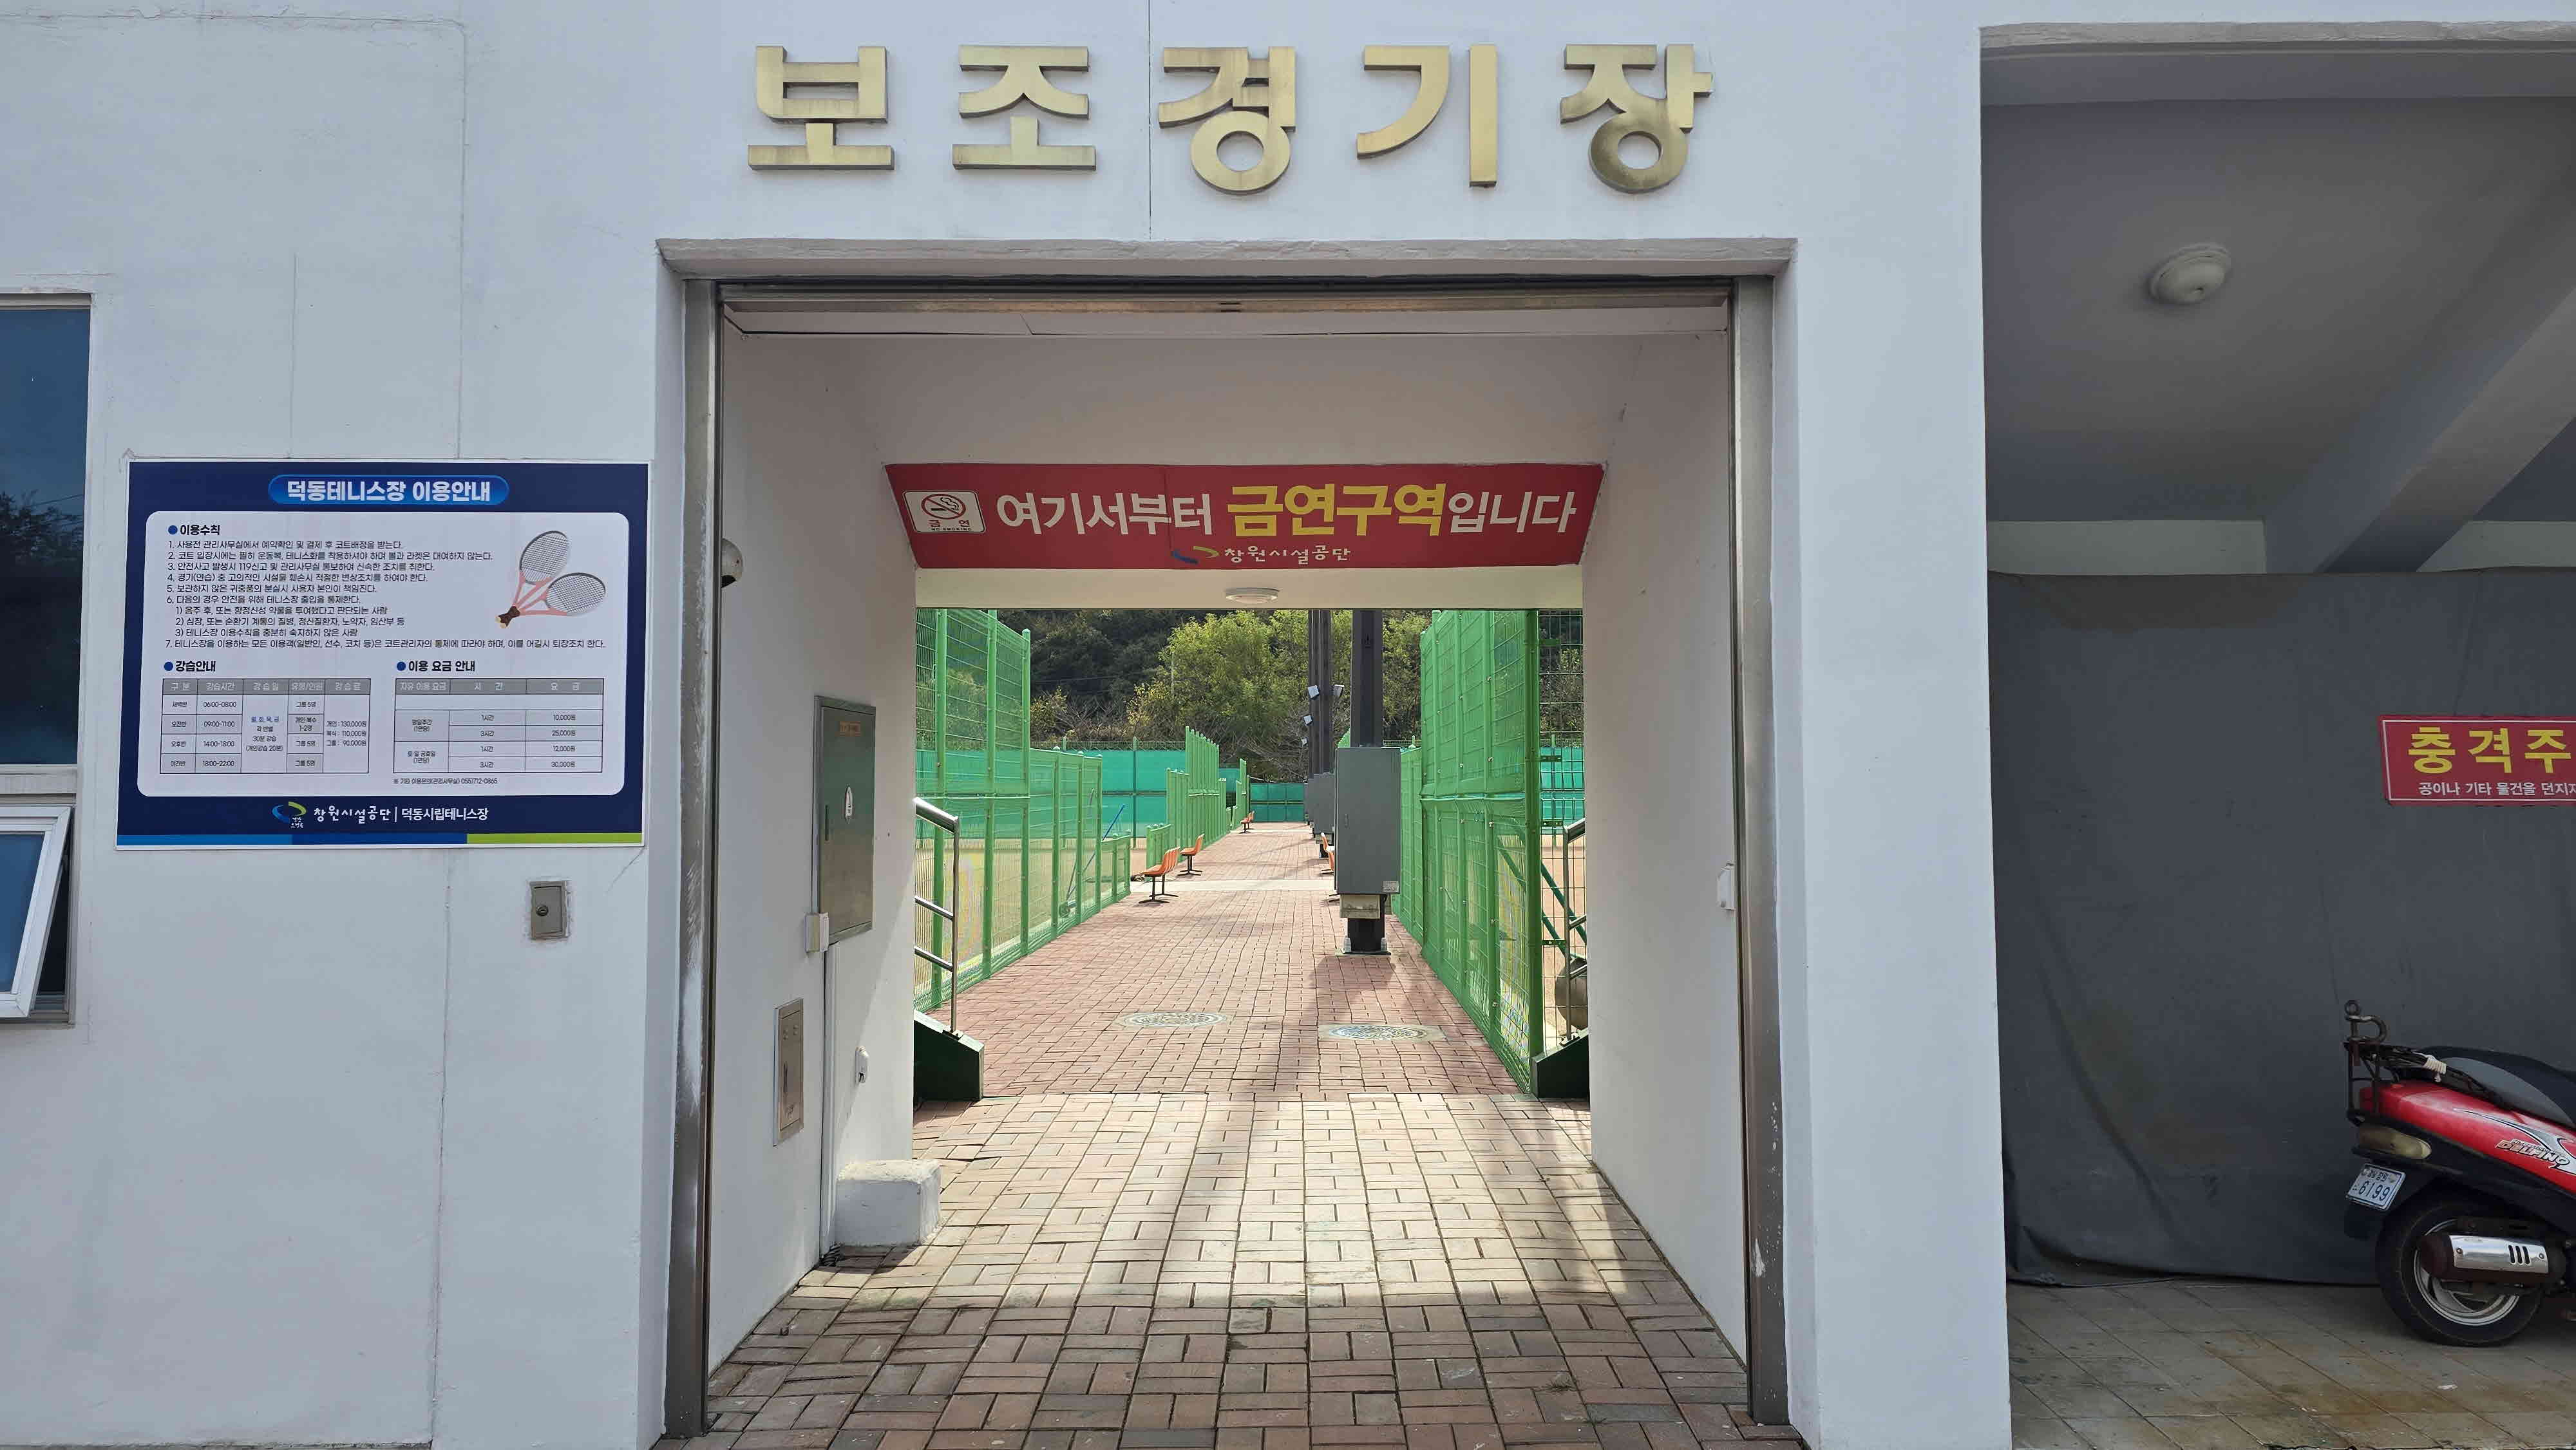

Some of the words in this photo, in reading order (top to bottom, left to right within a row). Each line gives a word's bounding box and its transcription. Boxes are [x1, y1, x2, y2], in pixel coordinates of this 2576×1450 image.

[748, 44, 1713, 195] 보조경기장
[288, 481, 406, 501] 덕동테니스장
[412, 481, 490, 501] 이용안내
[996, 493, 1211, 535] 여기서부터
[180, 525, 220, 535] 이용수칙
[1224, 545, 1351, 565] 창원시설공단
[166, 639, 172, 648] 7.
[175, 639, 214, 648] 테니스장을
[218, 639, 249, 648] 이용하는
[252, 639, 268, 648] 모든
[345, 639, 360, 648] 코치
[363, 639, 381, 648] 등)은
[384, 639, 432, 648] 코트관리자의
[462, 639, 485, 648] 따라야
[527, 639, 549, 648] 어길시
[553, 639, 584, 648] 퇴장조치
[175, 661, 216, 672] 강습안내
[408, 661, 428, 672] 이용
[431, 661, 451, 672] 요금
[455, 661, 475, 672] 안내
[2418, 782, 2460, 796] 공이나
[2465, 782, 2492, 795] 기타
[2496, 782, 2536, 795] 물건을
[314, 805, 391, 824] 창원시설공단
[401, 807, 489, 821] 덕동시립테니스장
[2495, 1139, 2570, 1167] DELFINO
[2358, 1180, 2391, 1201] 6199
